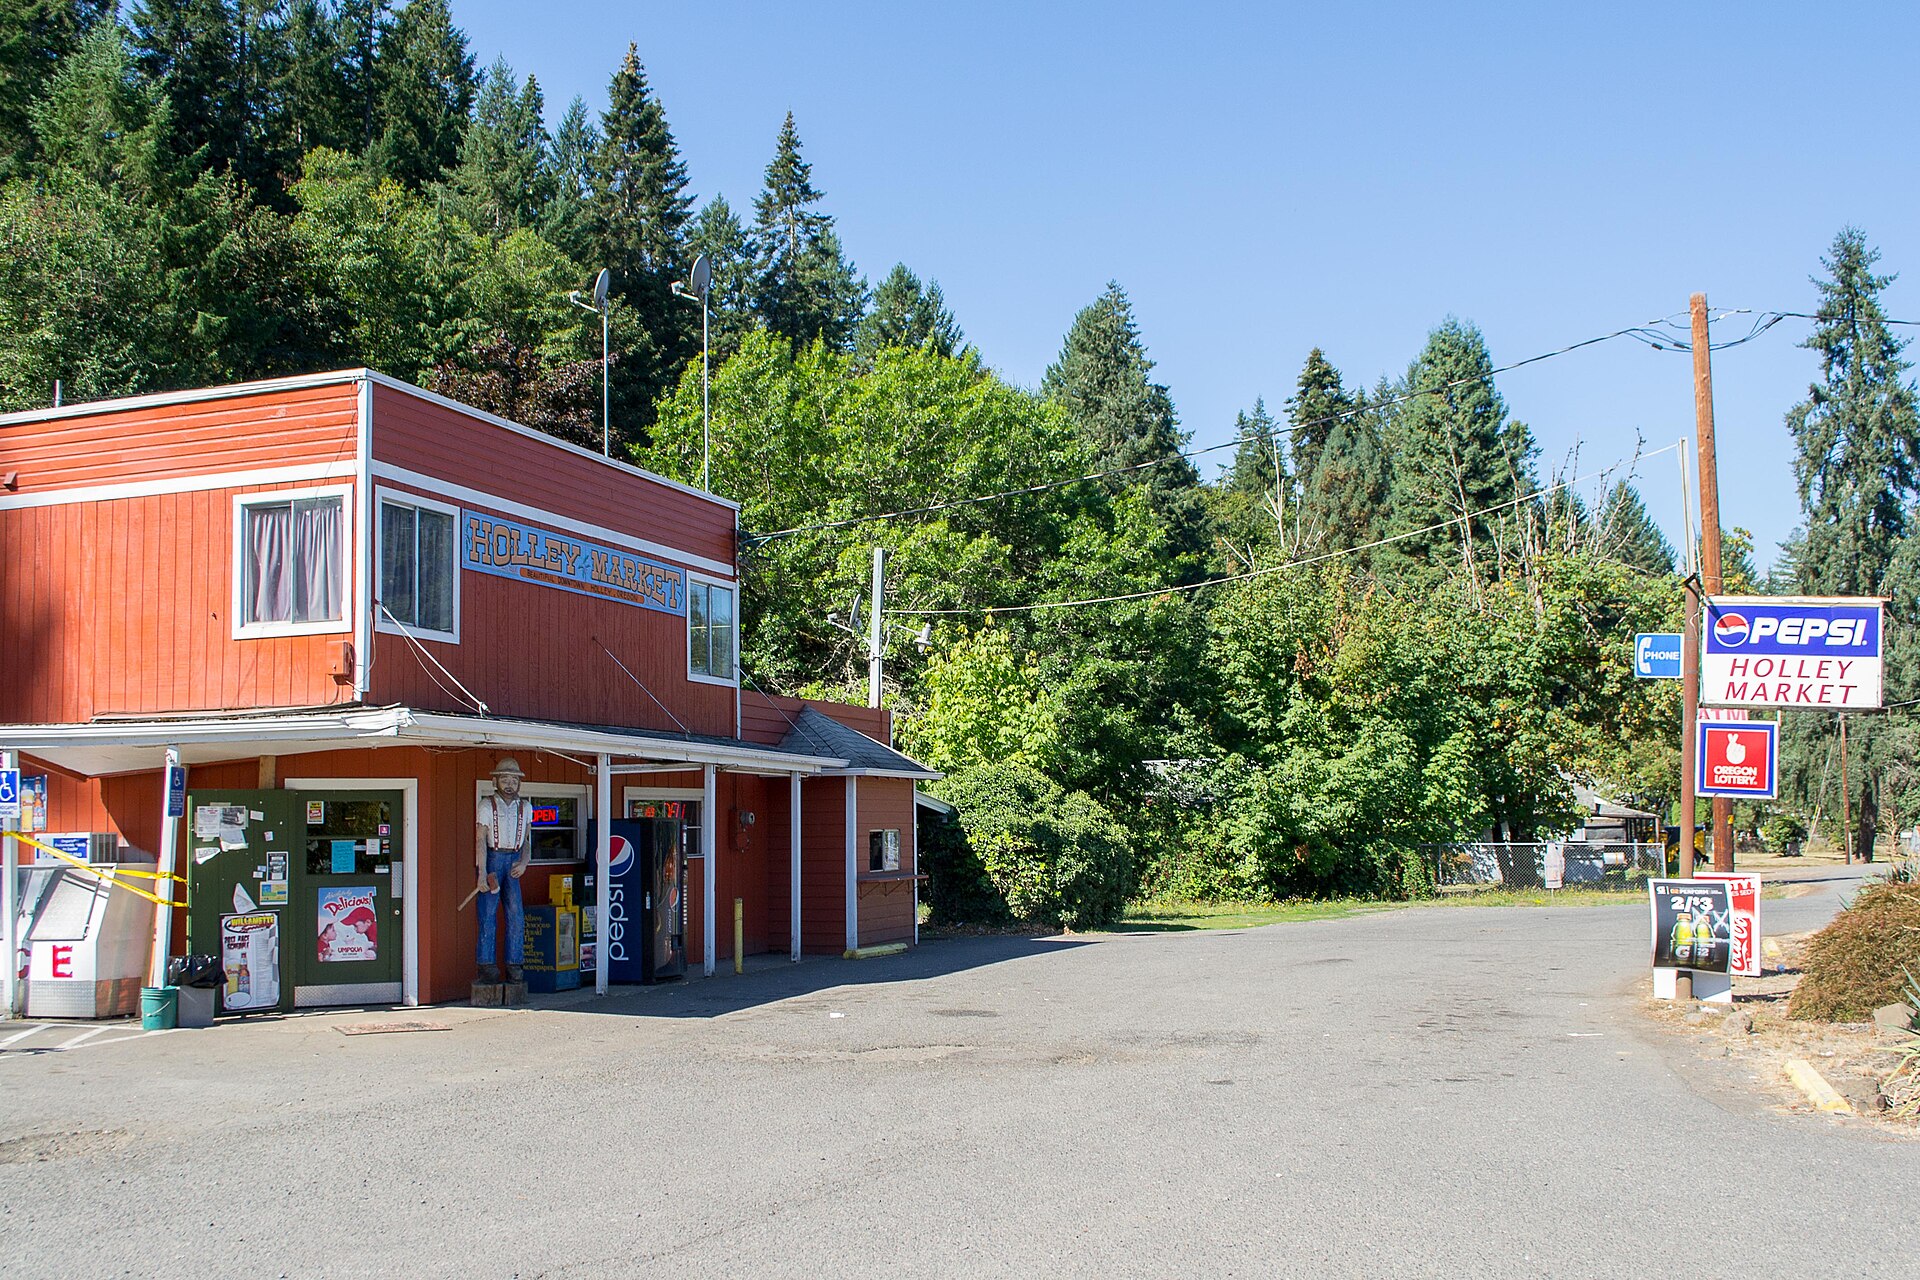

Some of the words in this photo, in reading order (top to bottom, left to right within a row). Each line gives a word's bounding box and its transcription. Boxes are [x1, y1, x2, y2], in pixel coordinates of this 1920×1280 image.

[469, 518, 581, 575] HOLLEY
[591, 549, 681, 609] MARKET
[527, 569, 554, 583] BEAUTIFUL
[557, 576, 585, 589] DOWNTOWN
[616, 589, 638, 602] OREGON
[1644, 651, 1680, 661] PHONE
[1729, 658, 1854, 679] HOLLEY
[1725, 681, 1858, 705] MARKET
[1698, 708, 1747, 721] ATM
[1713, 765, 1758, 776] OREGON
[323, 891, 373, 917] Delicious!
[1670, 896, 1714, 913] 2/$3
[230, 915, 275, 927] WILLAMETTE
[609, 884, 629, 961] pepsi
[52, 944, 73, 978] E
[1675, 945, 1690, 958] G
